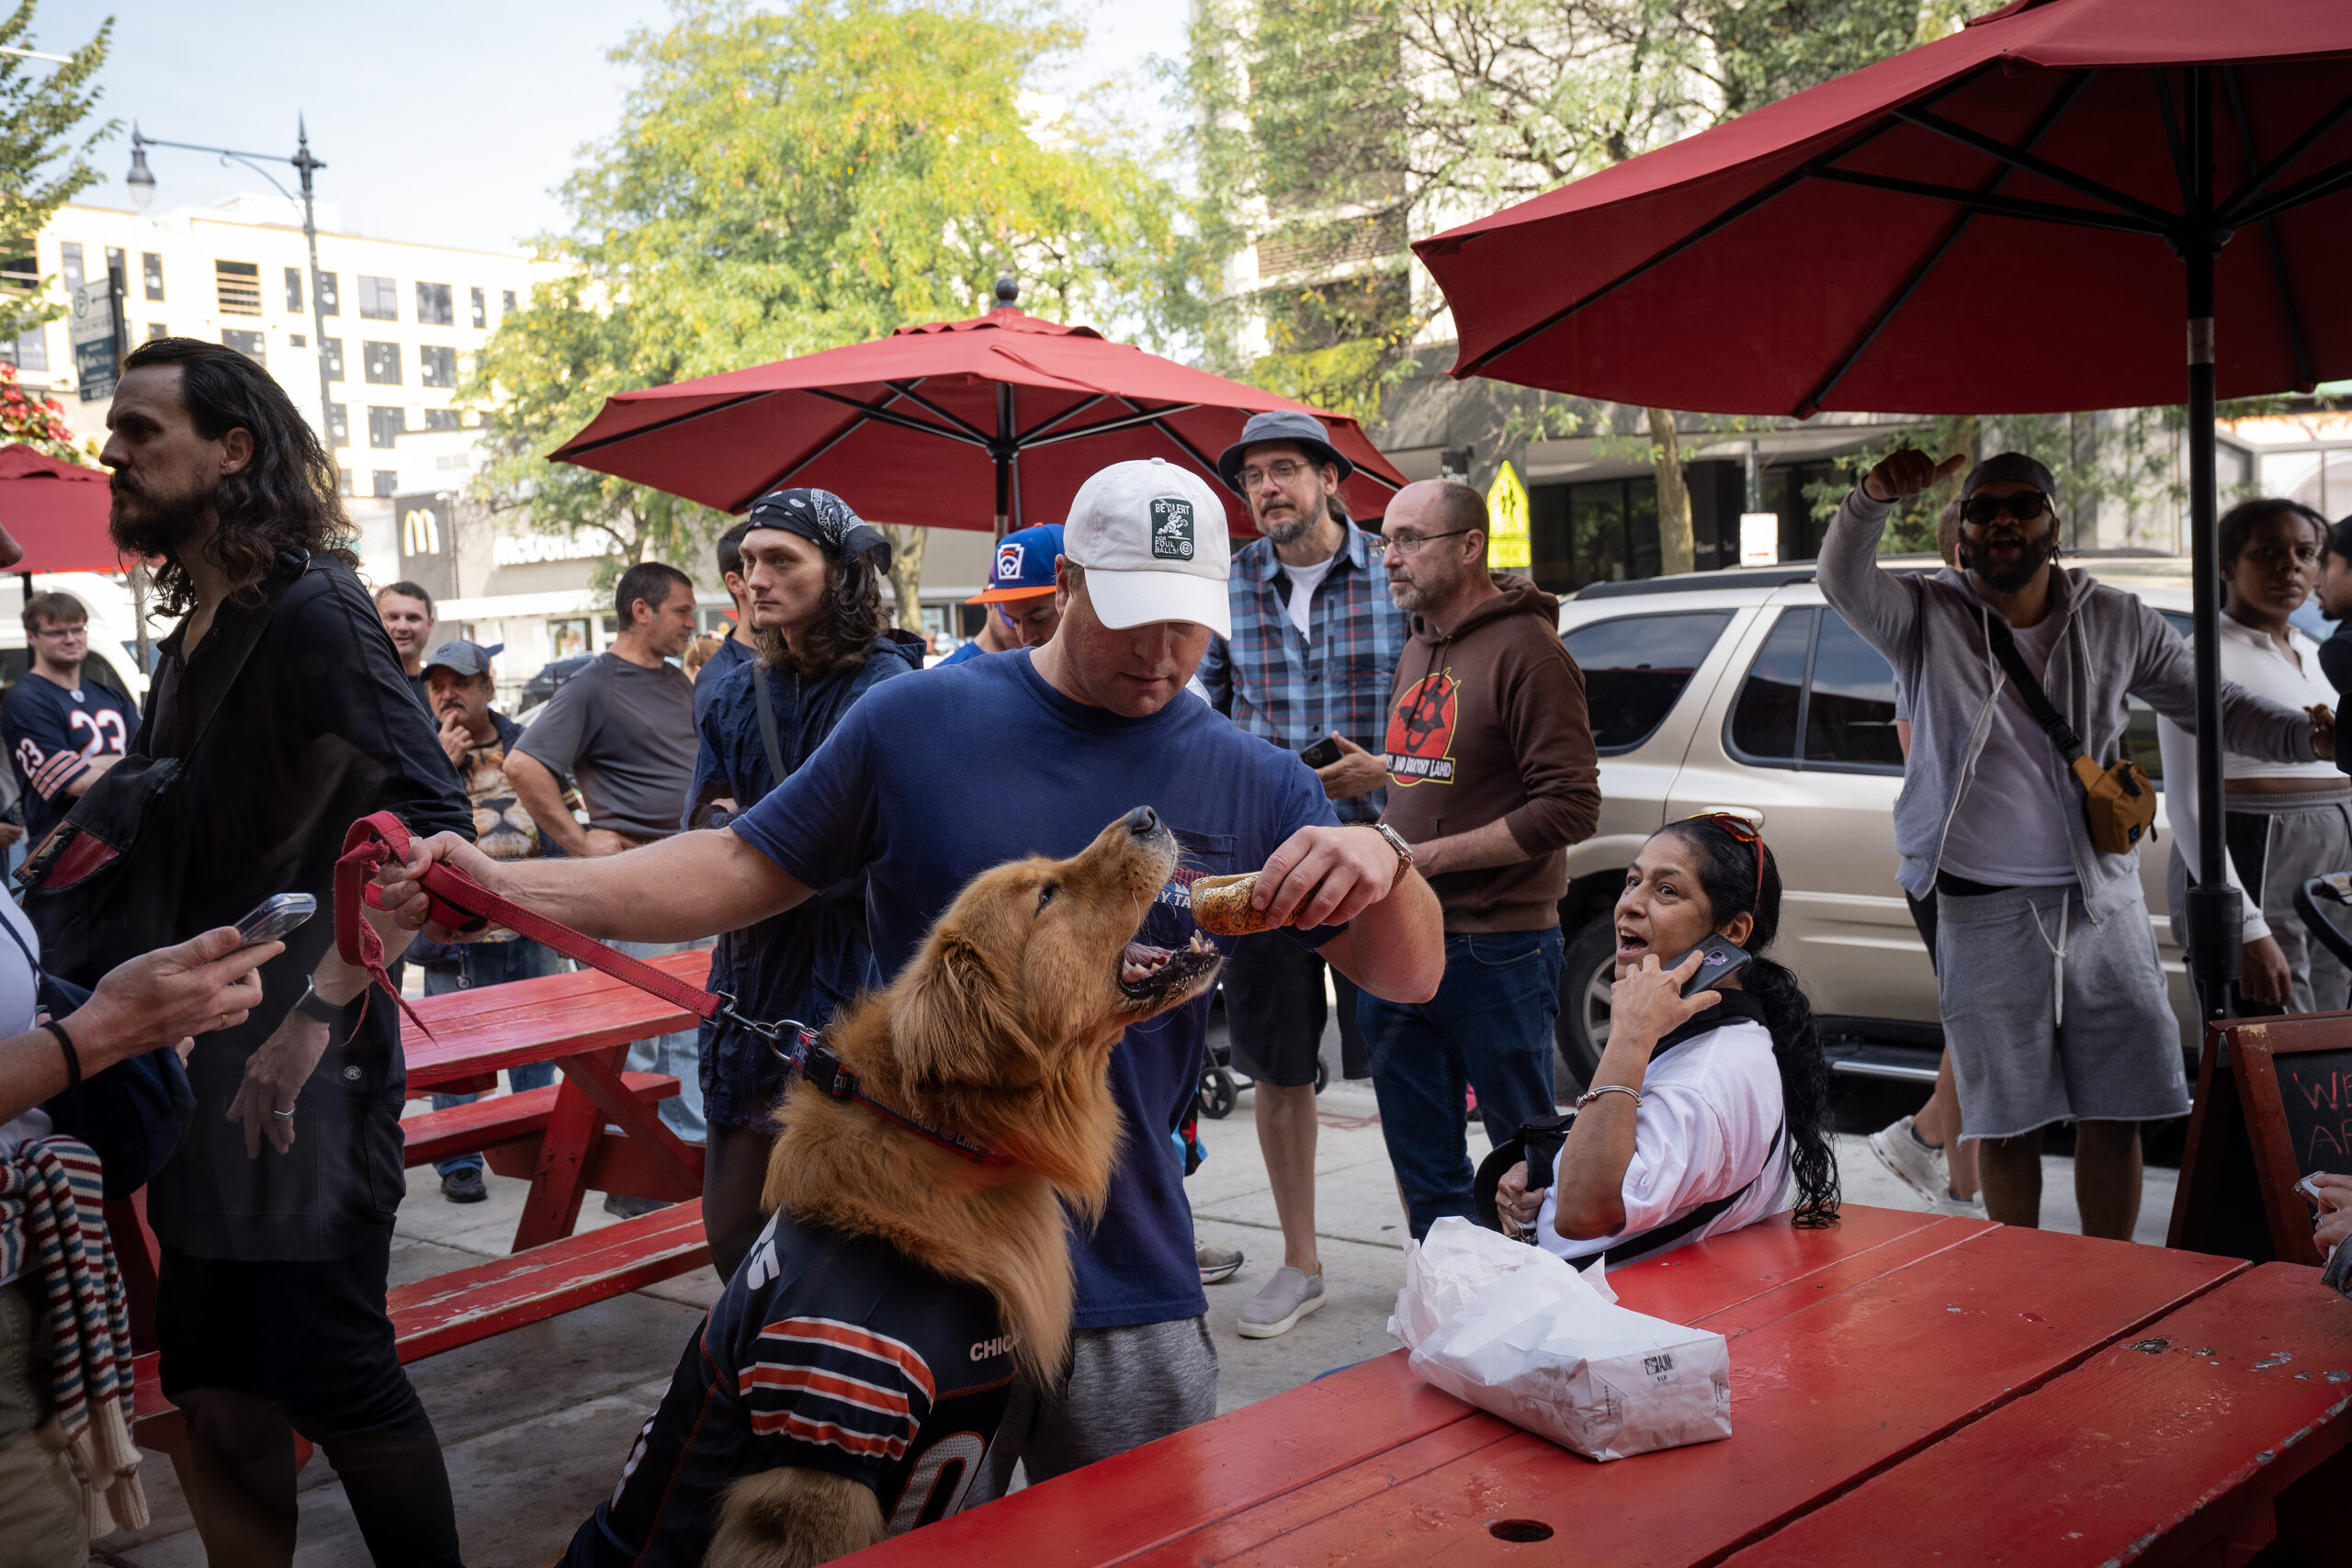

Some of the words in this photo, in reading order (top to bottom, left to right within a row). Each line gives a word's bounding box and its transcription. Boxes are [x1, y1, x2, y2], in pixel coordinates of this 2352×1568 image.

[1155, 503, 1166, 513] BE
[1155, 546, 1179, 554] BALLS!
[70, 708, 127, 759] 23
[16, 738, 45, 779] 23
[1430, 759, 1451, 778] LAND
